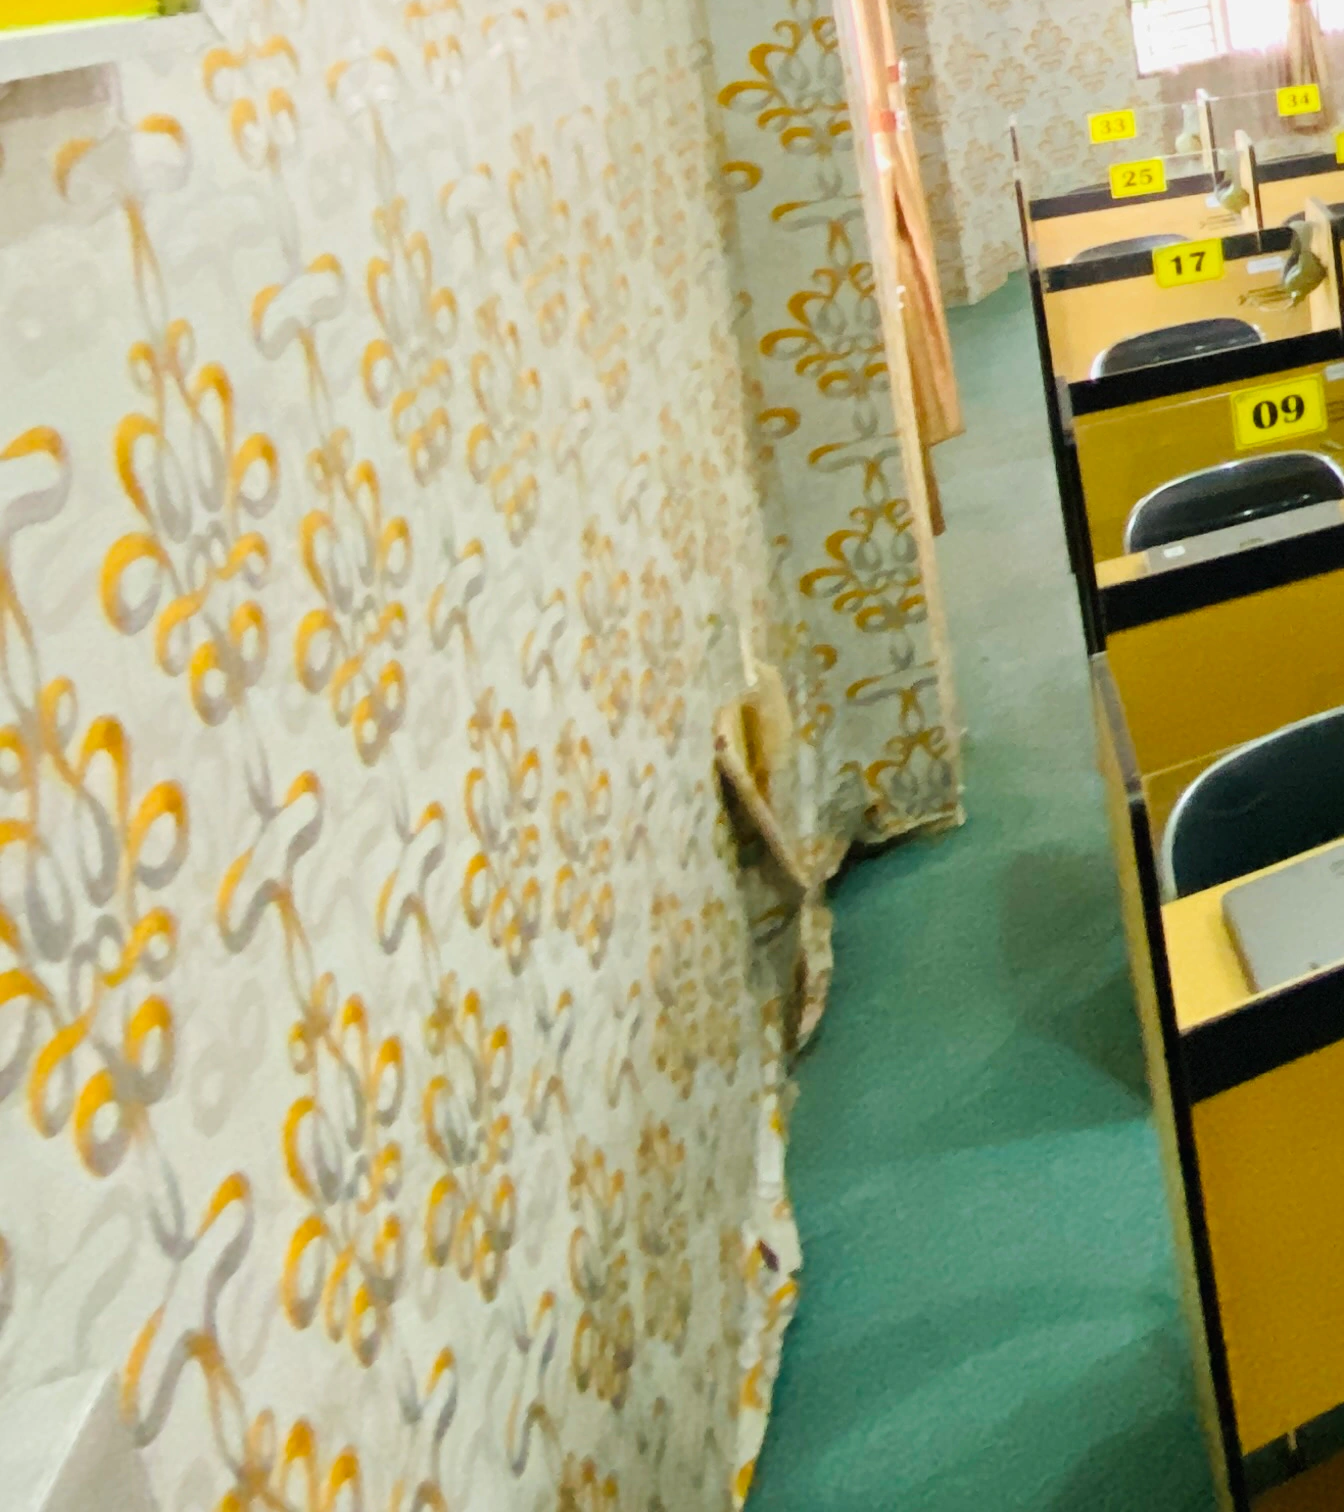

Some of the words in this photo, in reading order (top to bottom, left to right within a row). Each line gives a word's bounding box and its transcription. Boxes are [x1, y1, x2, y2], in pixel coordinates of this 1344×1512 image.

[1288, 92, 1310, 108] 34
[1100, 118, 1126, 134] 33
[1124, 169, 1153, 187] 25
[1172, 252, 1205, 275] 17
[1253, 395, 1304, 429] 09
